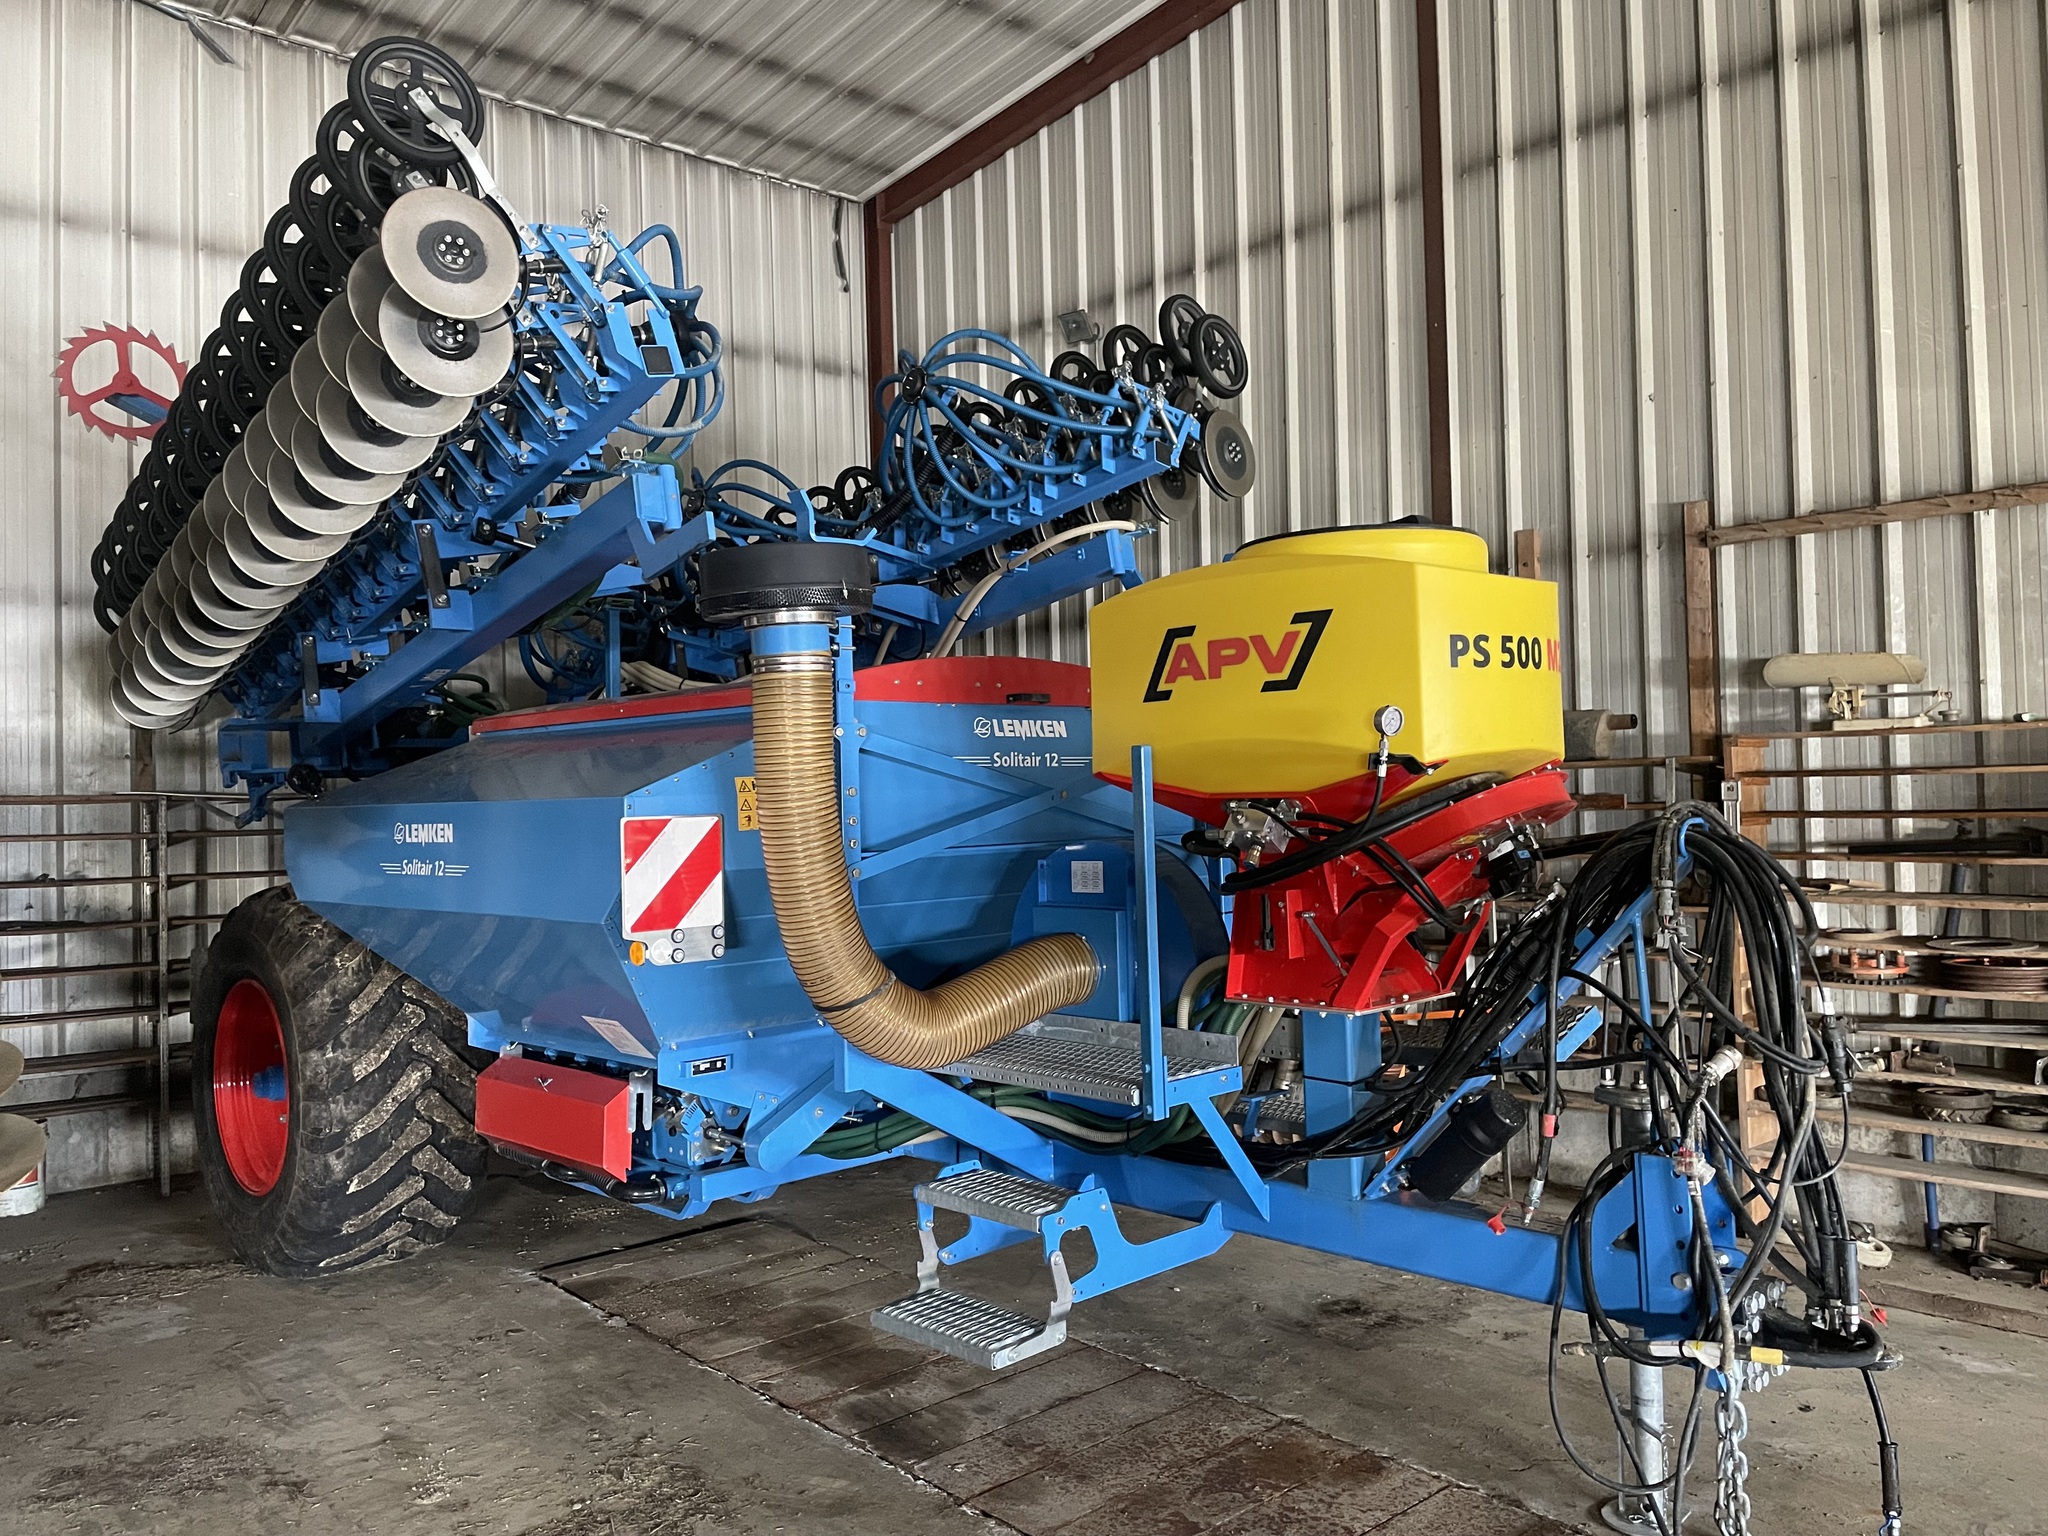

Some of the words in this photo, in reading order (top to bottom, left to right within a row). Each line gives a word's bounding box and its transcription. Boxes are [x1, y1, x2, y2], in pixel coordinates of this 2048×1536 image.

[1449, 634, 1491, 668] PS
[1500, 635, 1542, 670] 500
[992, 718, 1067, 741] LEMKEN
[993, 751, 1041, 767] Solitair
[1044, 752, 1059, 767] 12
[405, 823, 453, 846] LEMKEN
[402, 858, 433, 876] Solitair
[434, 860, 445, 876] 12
